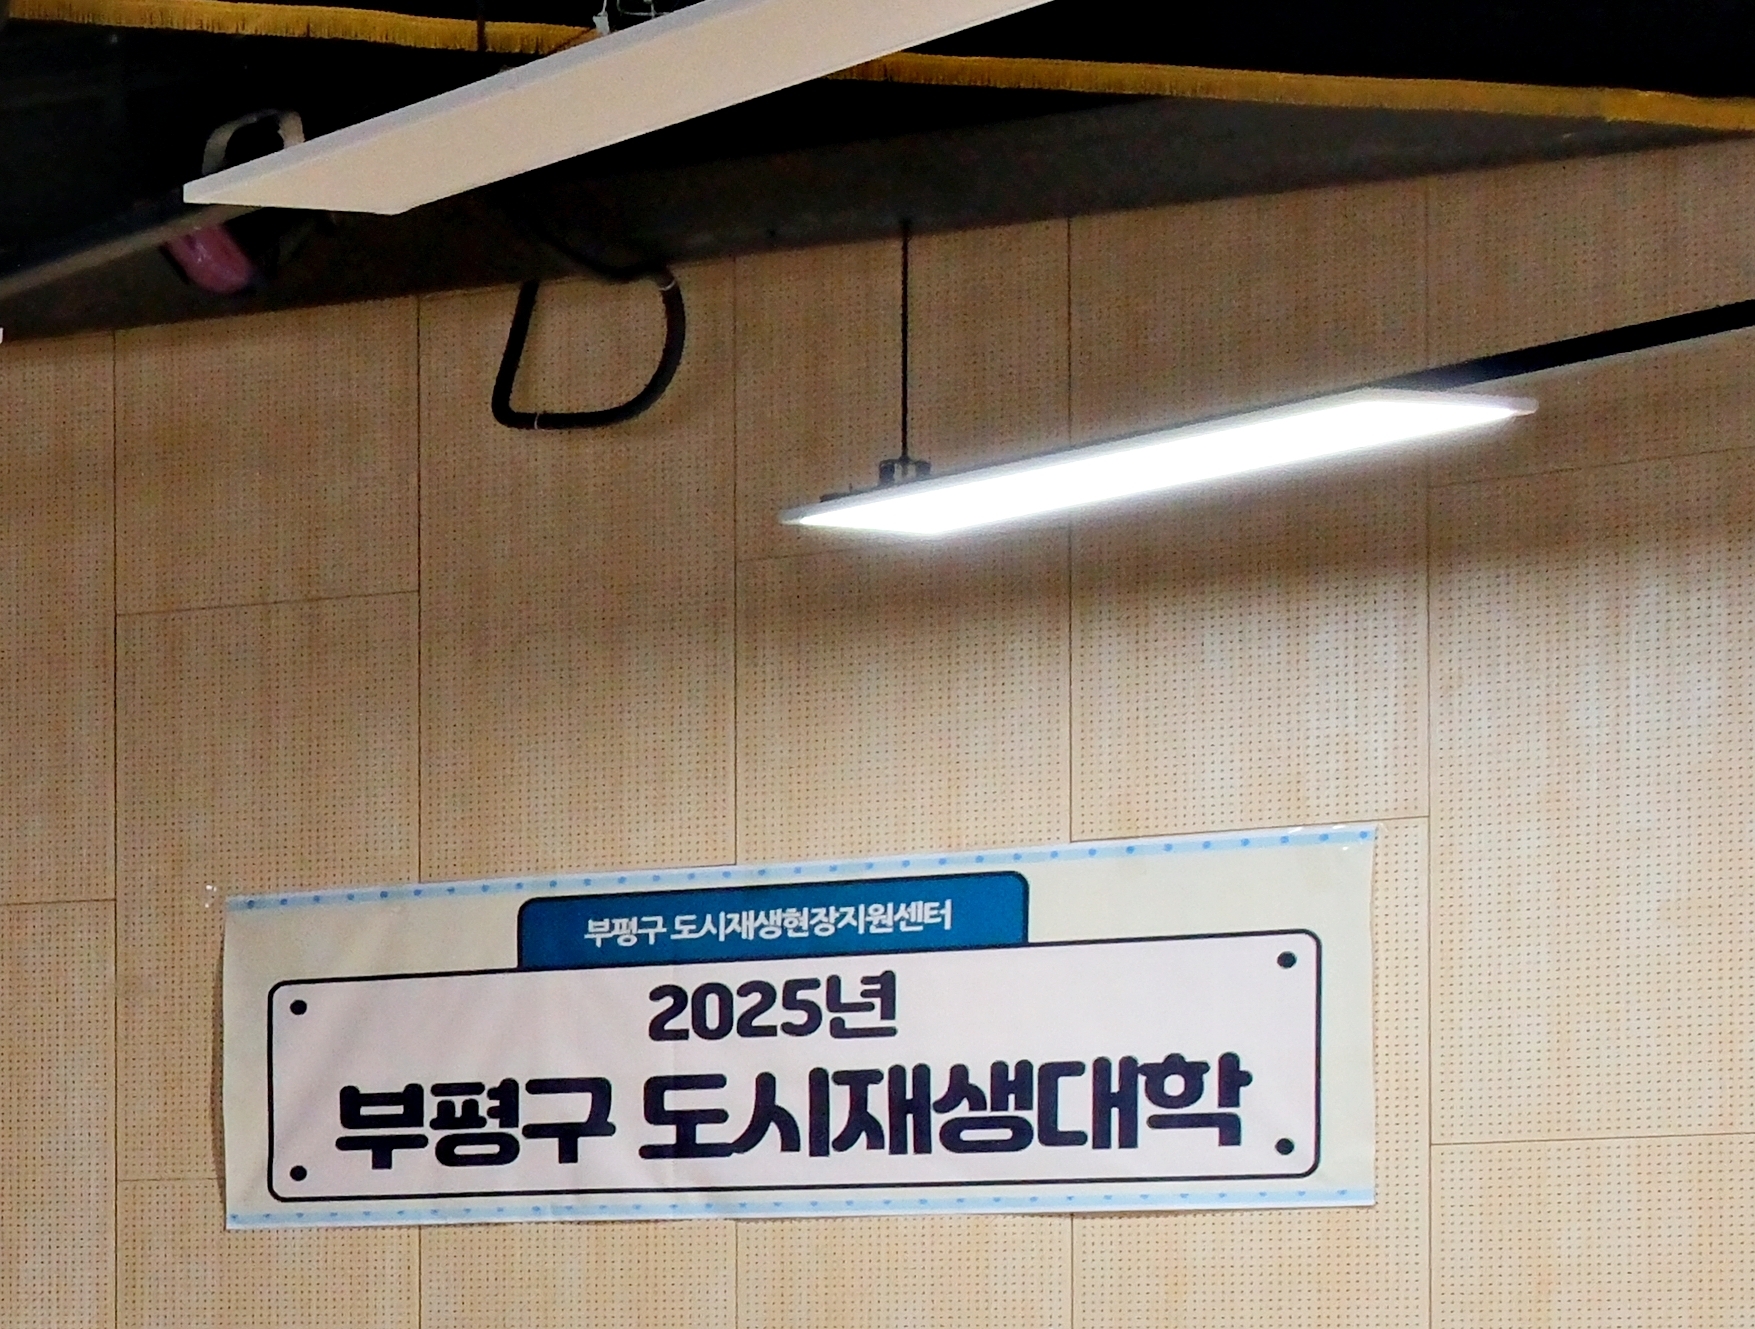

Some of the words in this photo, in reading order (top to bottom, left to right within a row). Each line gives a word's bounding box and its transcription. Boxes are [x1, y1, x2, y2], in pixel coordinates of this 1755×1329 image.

[584, 916, 667, 948] 부평구
[670, 898, 953, 943] 도시재생현장지원센터
[647, 971, 898, 1042] 2025년
[334, 1076, 617, 1170] 부평구
[638, 1052, 1253, 1160] 도시재생대학
